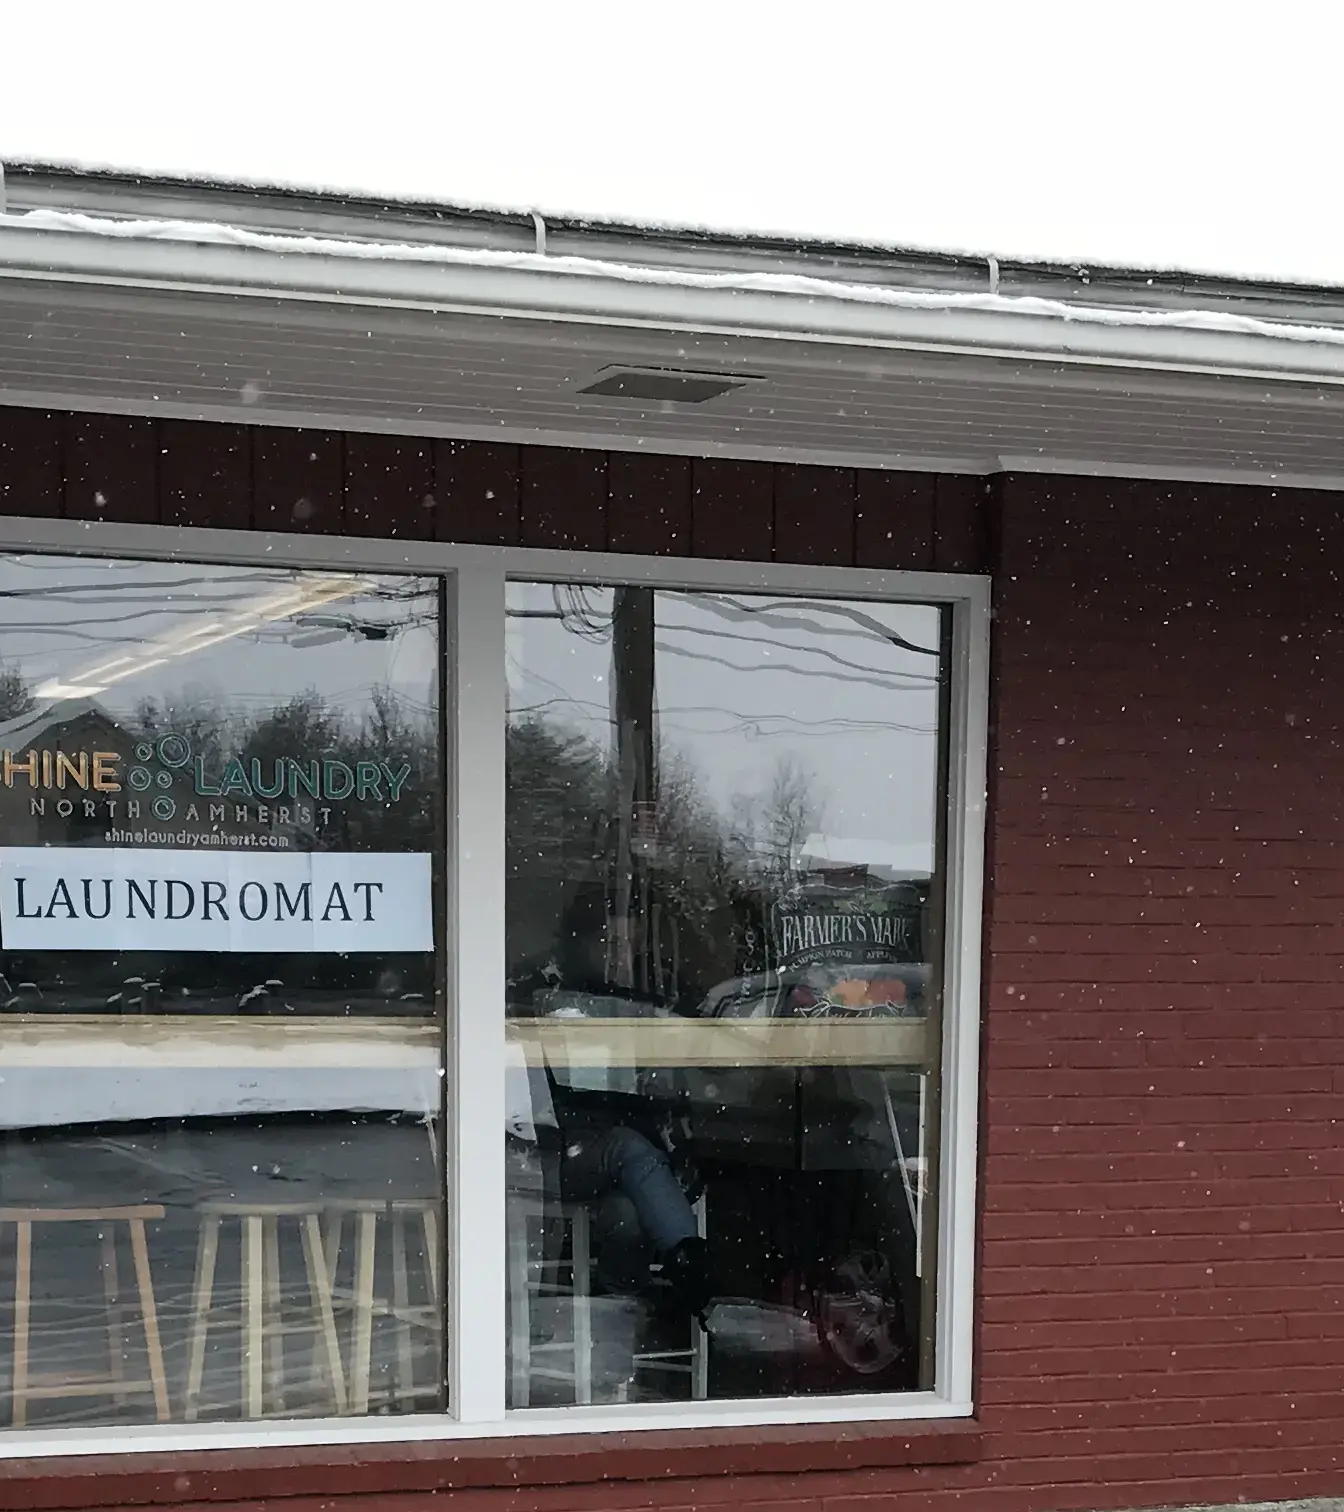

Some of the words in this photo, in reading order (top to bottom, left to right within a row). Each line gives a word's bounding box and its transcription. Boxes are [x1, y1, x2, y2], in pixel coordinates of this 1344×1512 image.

[194, 756, 412, 802] LAUNDRY
[29, 798, 141, 818] NORTH
[185, 803, 332, 825] AMHERST
[104, 828, 290, 848] shinelaundryamherst.com
[13, 876, 384, 924] LAUNDROMAT
[781, 914, 867, 957] FARMER'S
[869, 914, 915, 957] MARK
